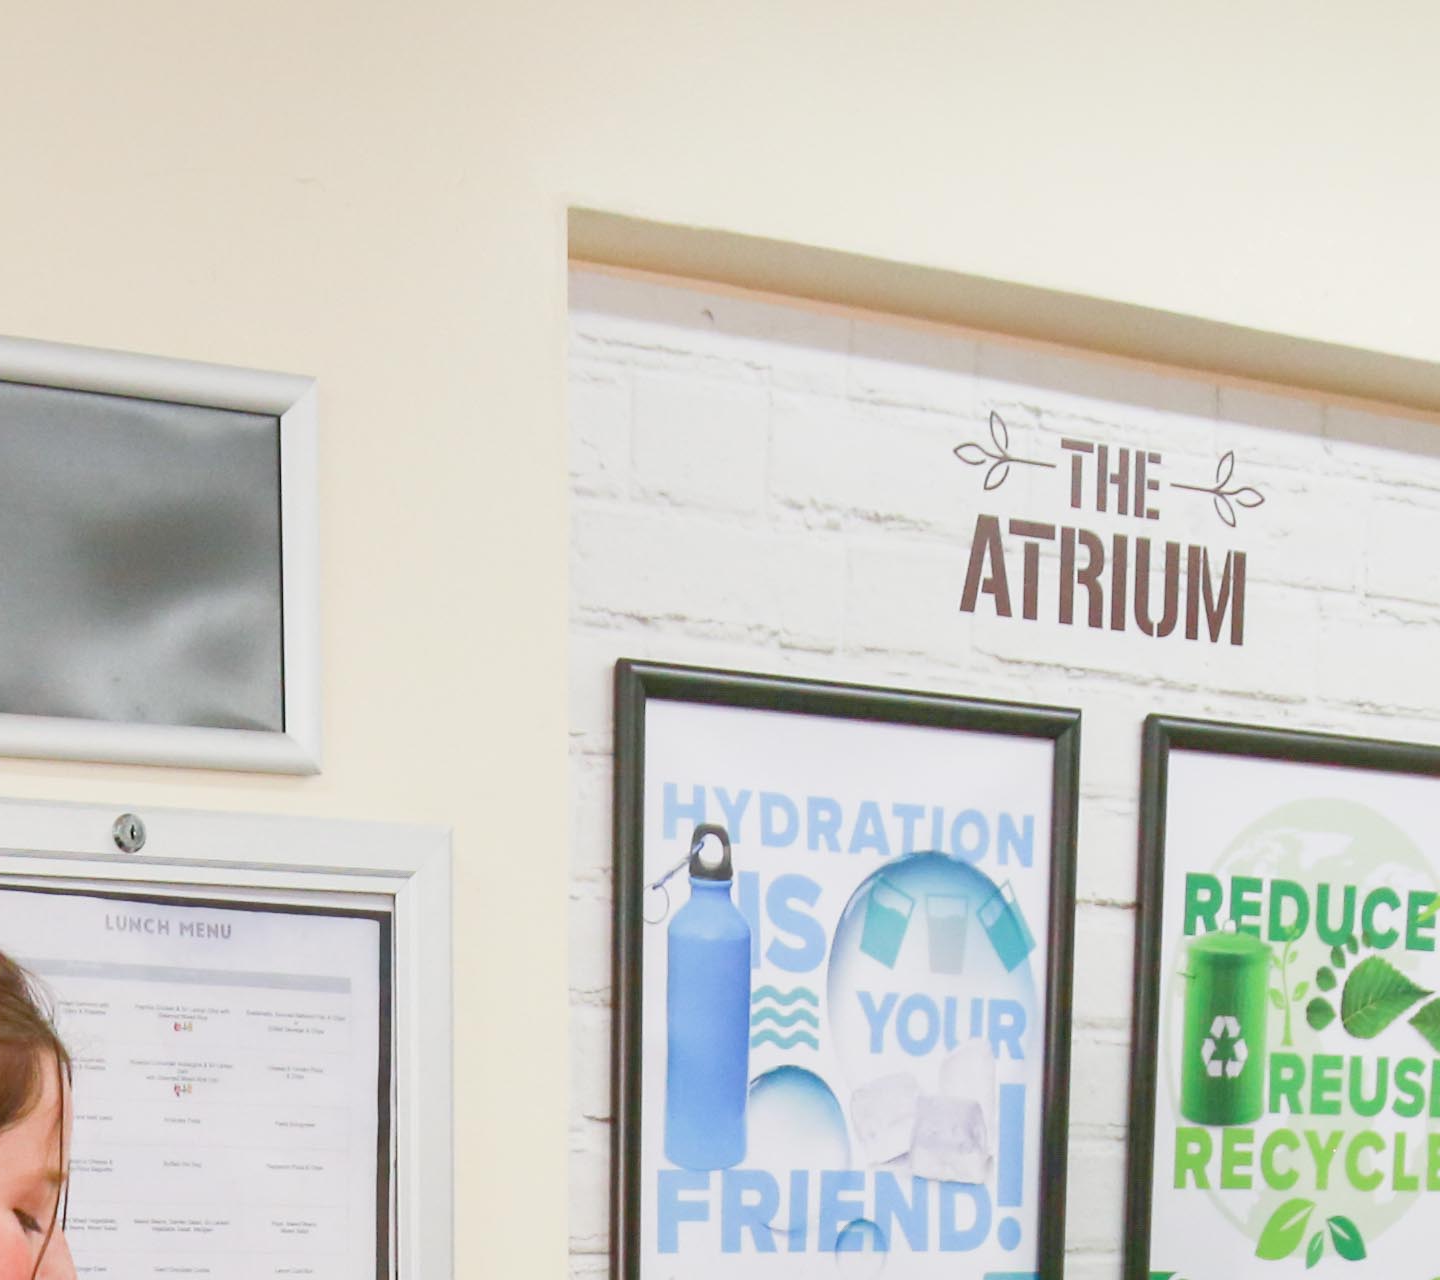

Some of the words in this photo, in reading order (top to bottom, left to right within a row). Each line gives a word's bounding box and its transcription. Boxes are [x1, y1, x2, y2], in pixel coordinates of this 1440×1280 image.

[1060, 438, 1161, 520] THE
[959, 513, 1247, 646] ATRIUM
[663, 782, 1035, 868] HYDRATION
[105, 914, 170, 935] LUNCH
[179, 921, 233, 940] MENU
[738, 871, 827, 973] IS
[1183, 872, 1439, 952] REDUCE
[856, 991, 1027, 1060] YOUR
[657, 1084, 1026, 1254] FRIEND!
